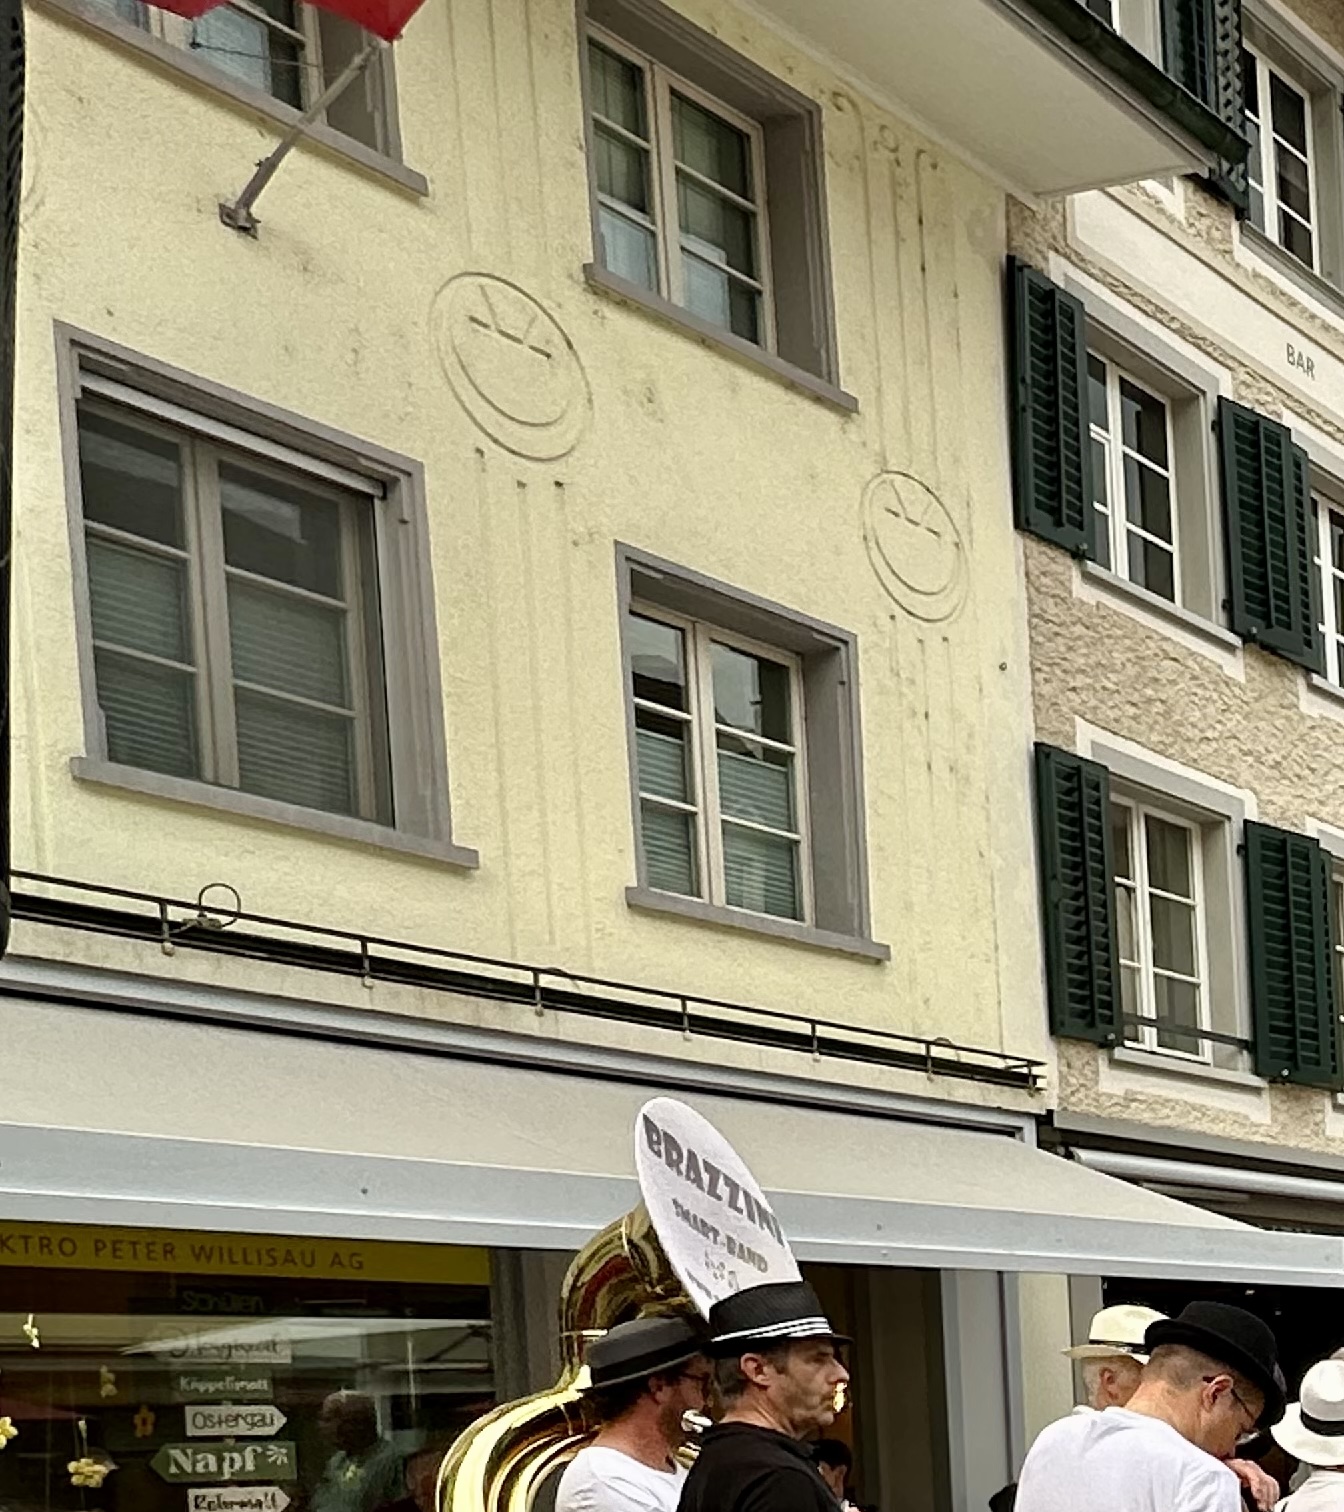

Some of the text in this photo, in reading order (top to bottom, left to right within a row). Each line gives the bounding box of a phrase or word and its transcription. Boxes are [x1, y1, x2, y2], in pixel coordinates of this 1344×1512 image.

[1286, 343, 1315, 380] BAR
[93, 1239, 176, 1263] PETER
[190, 1245, 317, 1268] WILLISAU
[330, 1252, 364, 1270] AG
[168, 1445, 262, 1480] Napf
